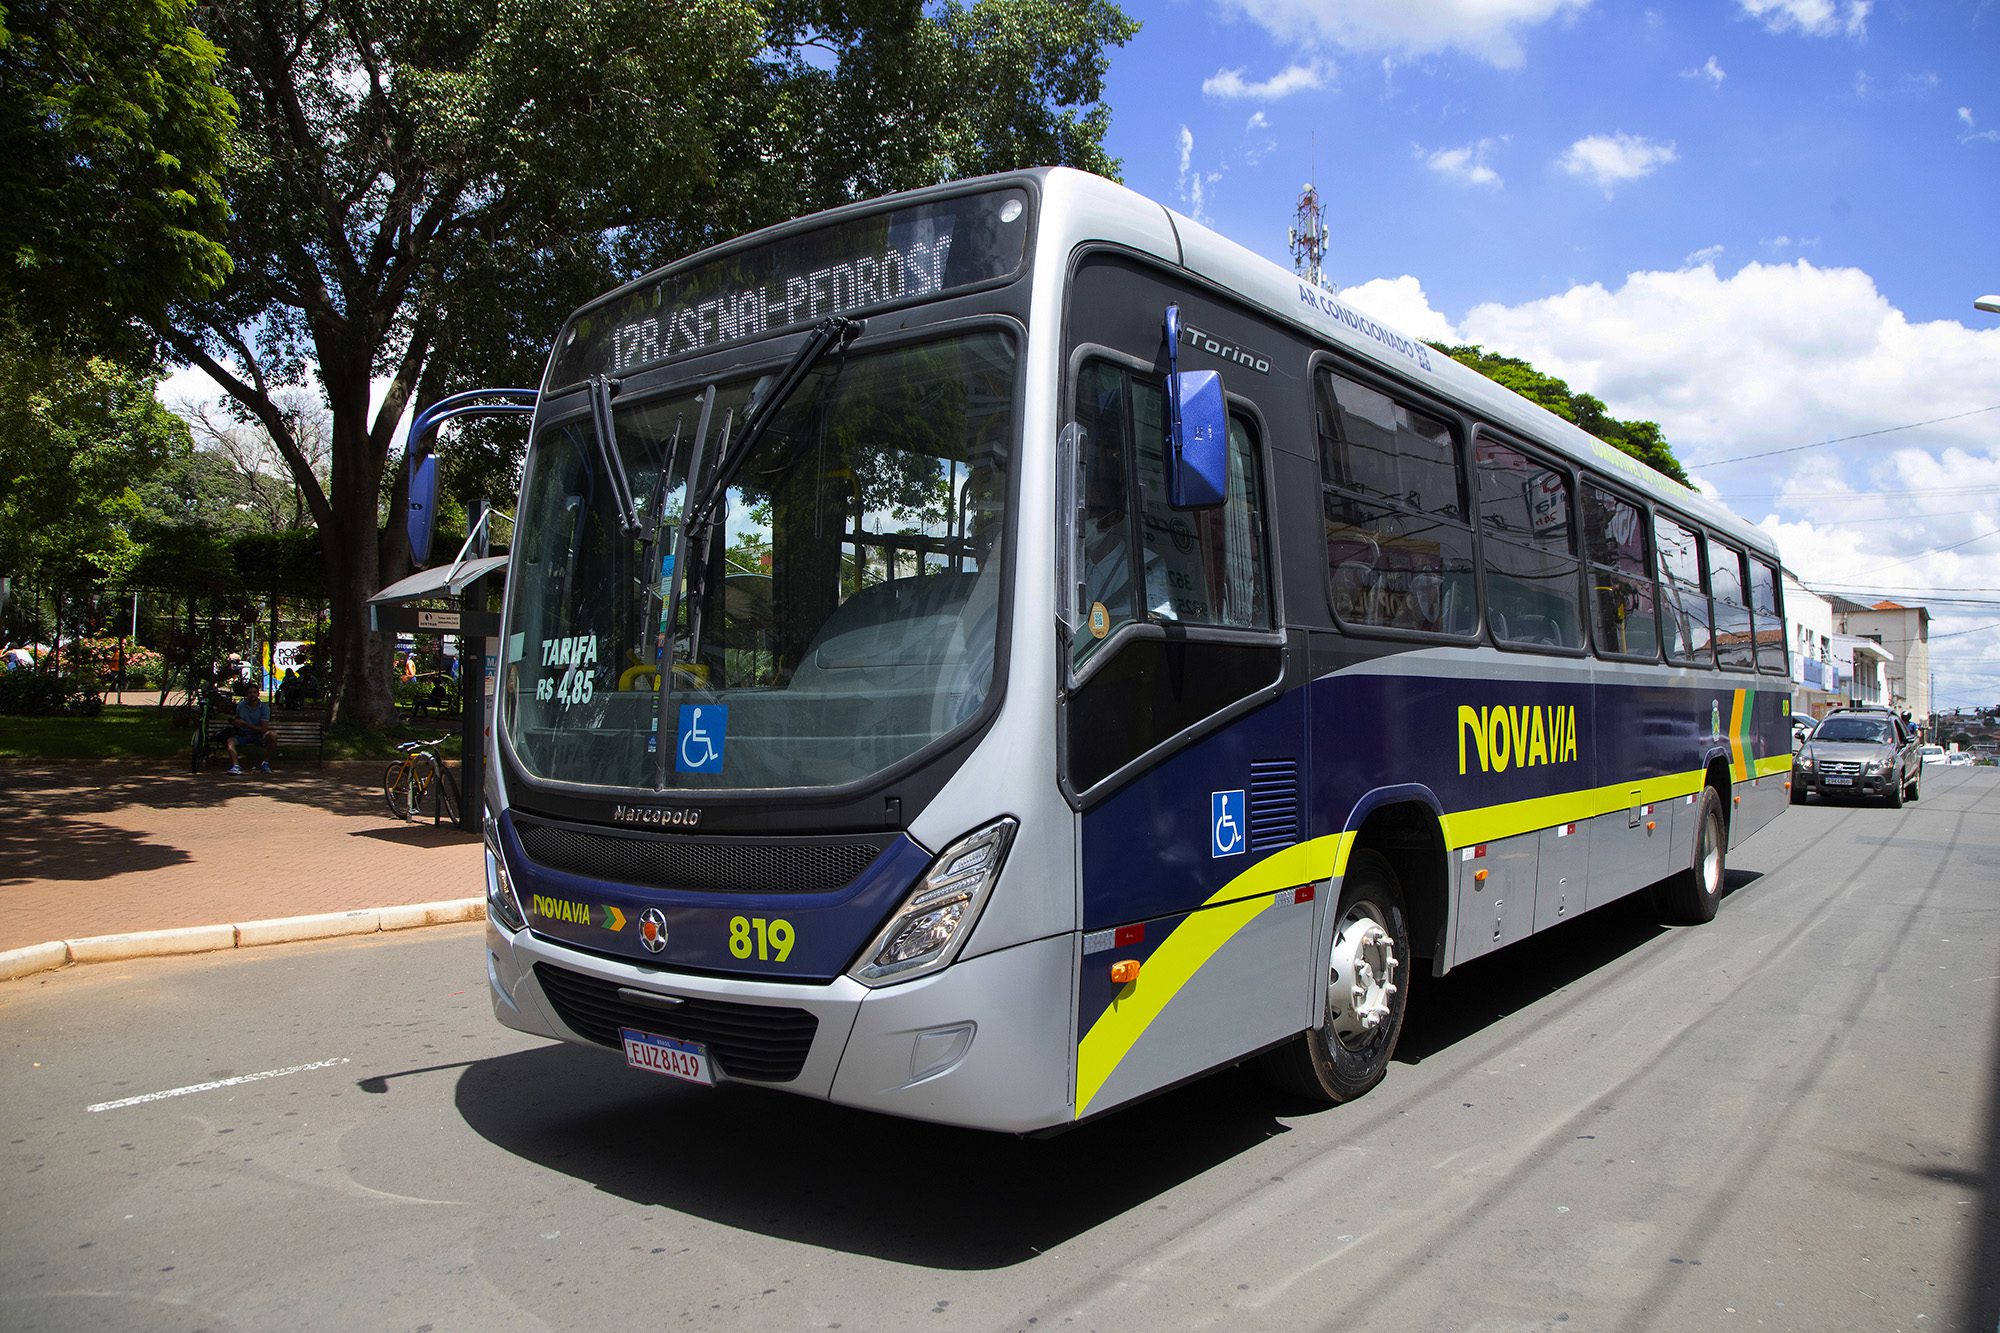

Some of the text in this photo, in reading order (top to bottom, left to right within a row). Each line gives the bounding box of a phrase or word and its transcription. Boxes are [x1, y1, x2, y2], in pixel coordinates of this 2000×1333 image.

[1298, 283, 1415, 359] AR CONDICIONADO
[1185, 326, 1271, 374] Torino
[278, 648, 299, 657] POP
[541, 635, 598, 667] TARIFA
[536, 678, 554, 704] R$
[556, 669, 596, 712] 4,85
[1457, 703, 1578, 776] NOVAVIA
[613, 804, 700, 827] Marcopolo
[728, 915, 796, 963] 819
[631, 1042, 700, 1078] EUZ8A19
